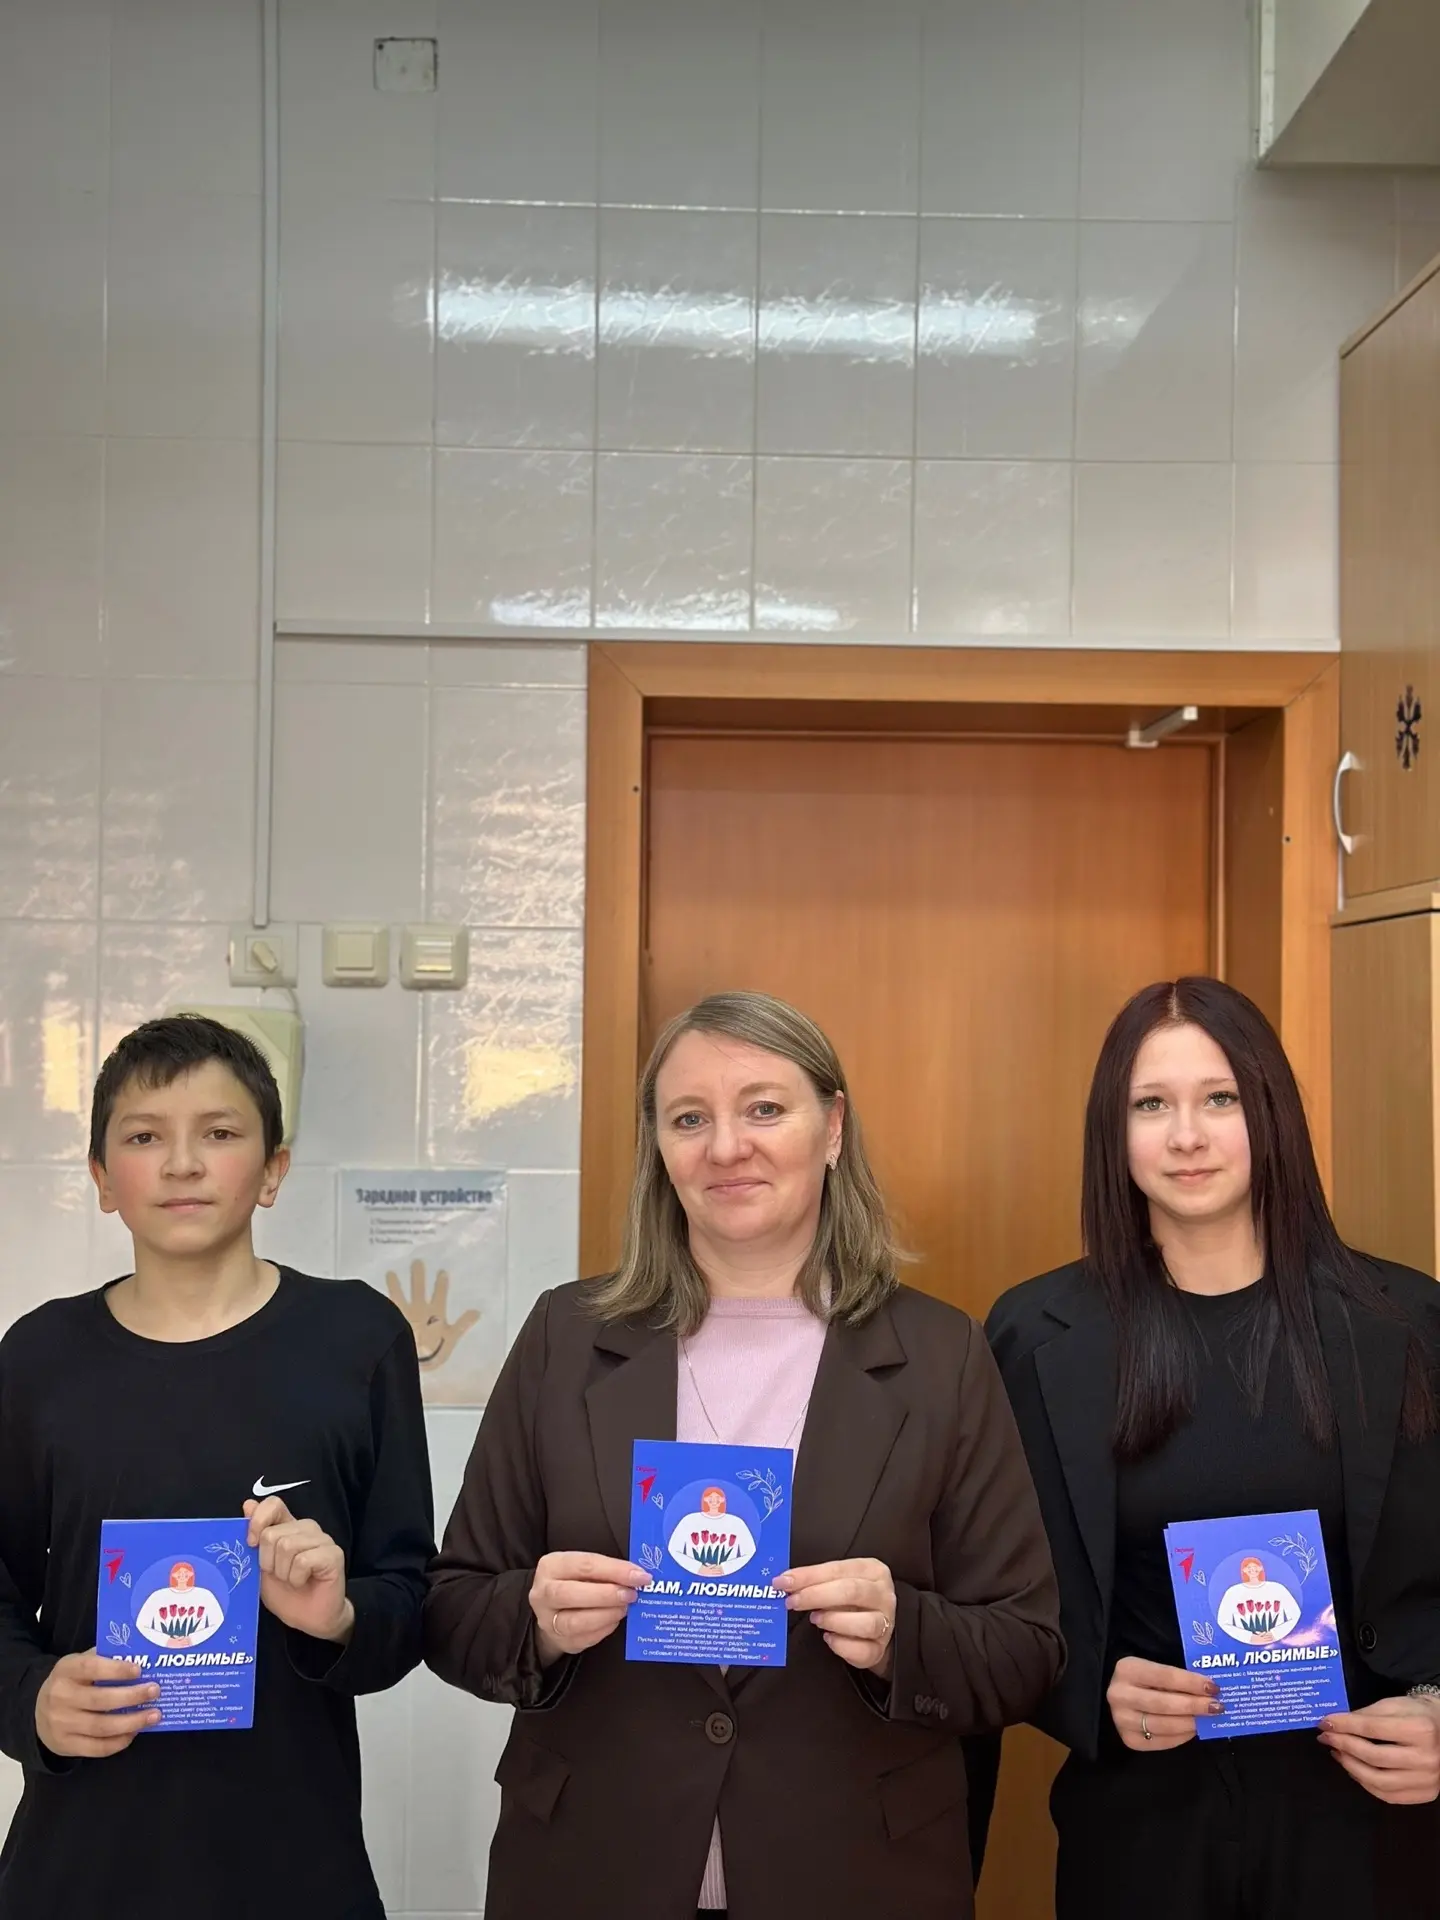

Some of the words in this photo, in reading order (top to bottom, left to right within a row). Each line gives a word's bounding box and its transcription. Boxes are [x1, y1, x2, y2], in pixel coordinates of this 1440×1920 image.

[356, 1188, 417, 1206] Зарядное
[420, 1187, 493, 1206] устройство
[687, 1581, 786, 1599] ЛЮБИМЫЕ»
[155, 1652, 254, 1667] ЛЮБИМЫЕ»
[1193, 1653, 1240, 1668] «ВАМ,
[1243, 1646, 1339, 1665] ЛЮБИМЫЕ»
